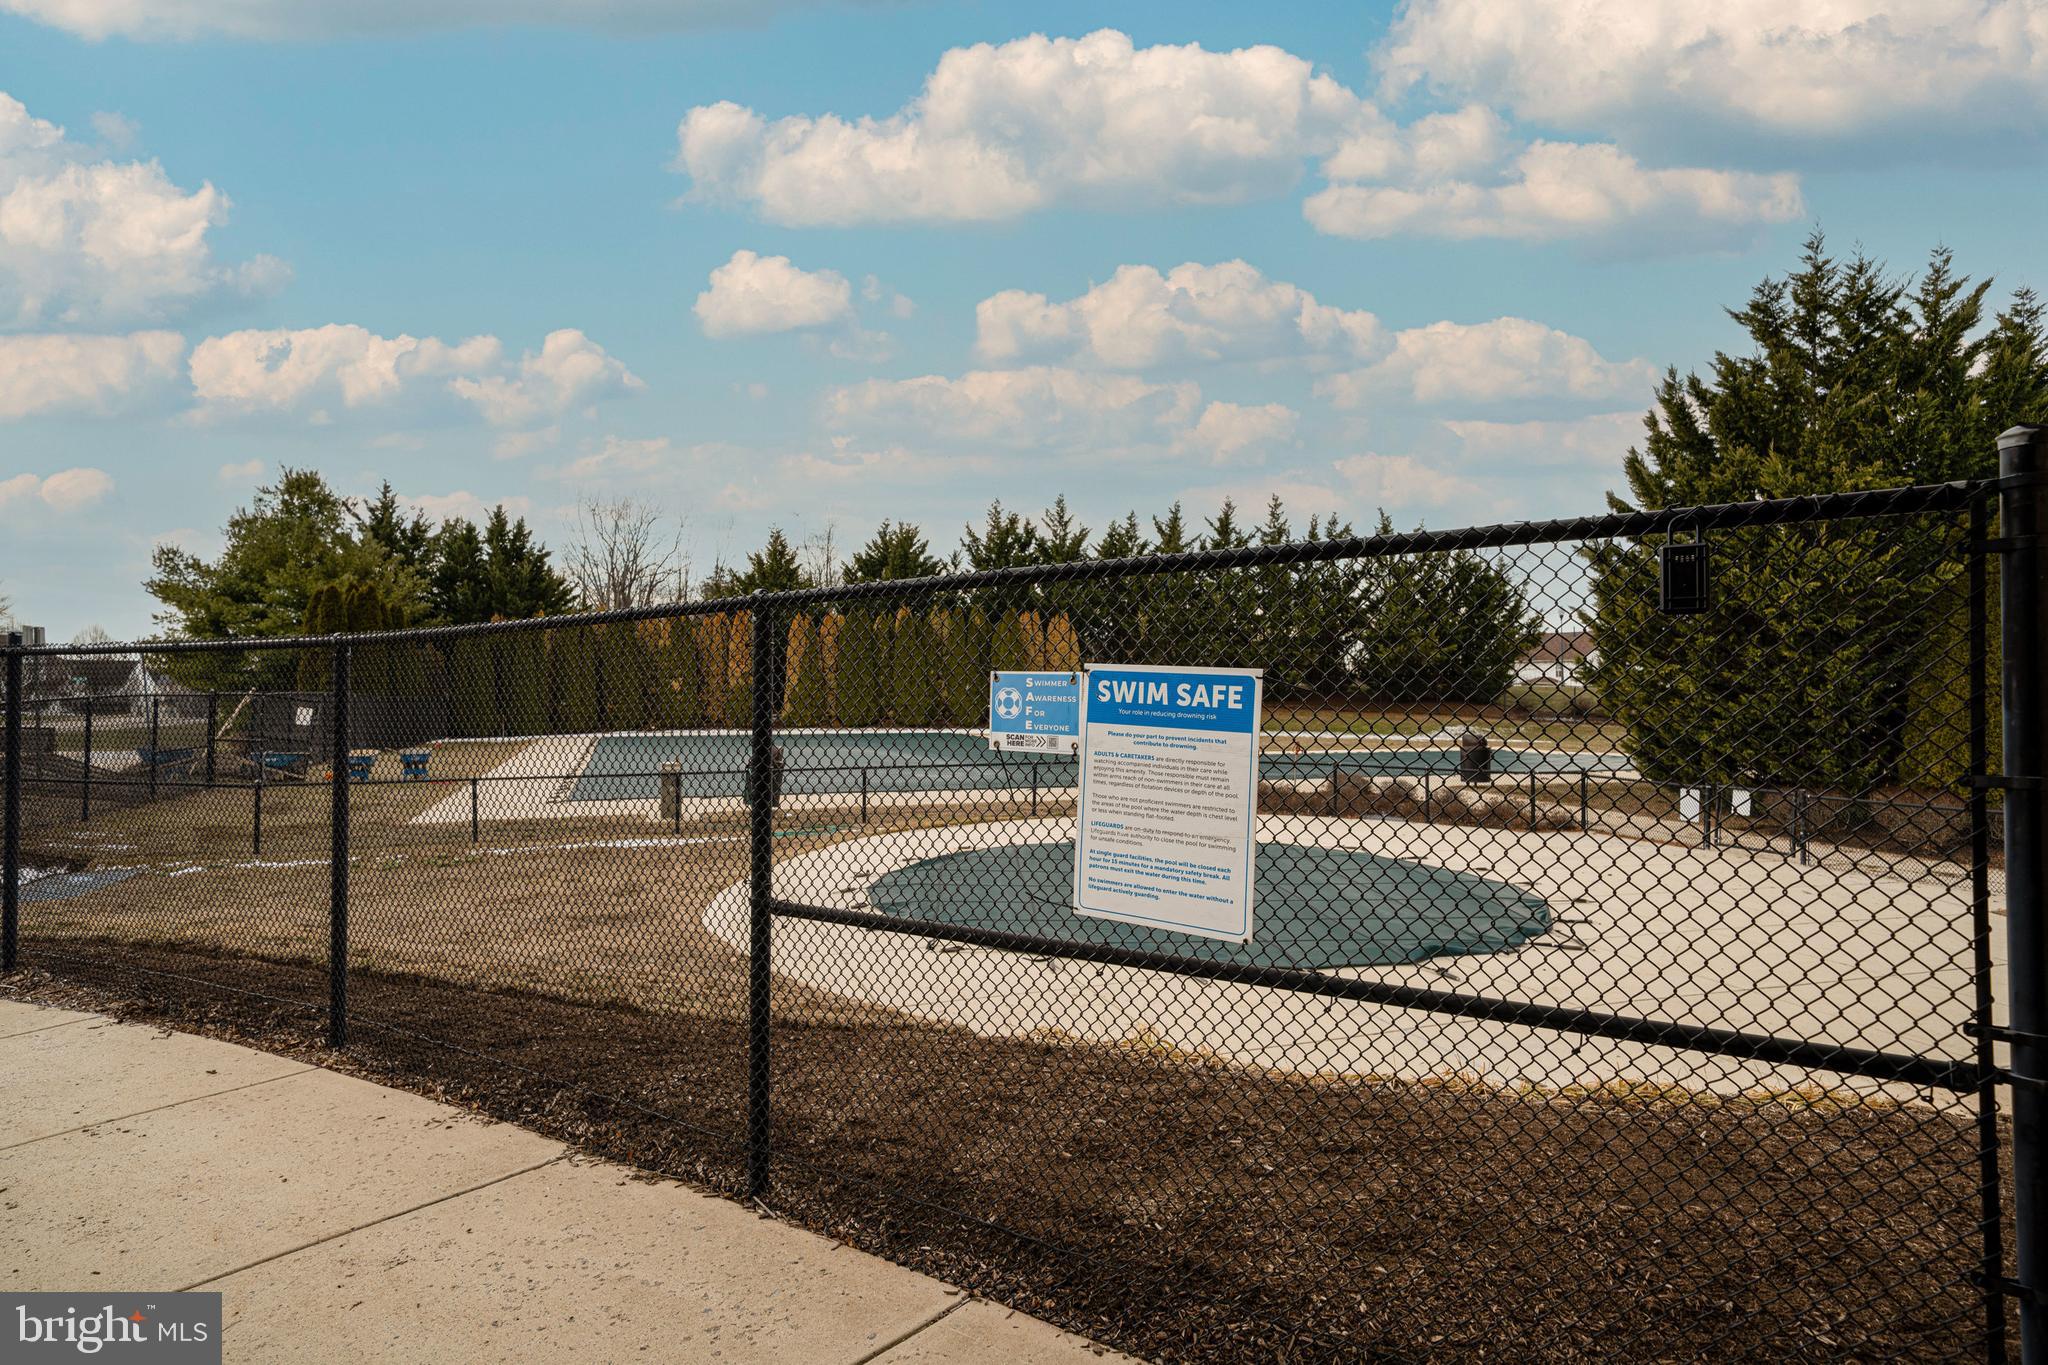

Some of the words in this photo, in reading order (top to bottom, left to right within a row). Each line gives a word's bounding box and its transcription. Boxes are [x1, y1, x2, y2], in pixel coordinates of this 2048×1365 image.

[1026, 678, 1068, 688] SWIMMER
[1026, 692, 1077, 702] AWARENESS
[1097, 680, 1168, 705] SWIM
[1177, 683, 1243, 709] SAFE
[1026, 706, 1045, 717] FOR
[1150, 710, 1176, 719] reducing
[1176, 712, 1205, 720] drowning
[1026, 720, 1070, 732] EVERYONE
[1165, 735, 1187, 743] prevent
[1093, 758, 1116, 767] watching
[1120, 753, 1155, 761] CARETAKERS
[1165, 757, 1184, 765] directly
[1186, 758, 1216, 768] responsible
[1093, 765, 1114, 773] enjoying
[1164, 771, 1194, 781] responsible
[1108, 780, 1134, 789] regardless
[1191, 789, 1207, 797] depth
[1138, 798, 1164, 807] proficient
[1164, 801, 1192, 809] swimmers
[1202, 804, 1228, 813] restricted
[1123, 810, 1145, 819] standing
[1187, 810, 1202, 819] depth
[1090, 820, 1124, 830] LIFEGUARDS
[1134, 826, 1154, 835] on-duty
[1162, 830, 1184, 839] respond
[1130, 833, 1153, 842] authority
[1185, 840, 1198, 848] pool
[1207, 843, 1236, 853] swimming
[1096, 849, 1112, 858] single
[1112, 852, 1129, 860] guard
[1164, 859, 1178, 867] pool
[1089, 862, 1109, 872] patrons
[1161, 873, 1180, 882] during
[1118, 860, 1140, 868] minutes
[1154, 865, 1184, 876] mandatory
[1185, 869, 1202, 878] safety
[1097, 878, 1123, 887] swimmers
[1133, 883, 1155, 892] allowed
[1206, 895, 1228, 904] without
[1112, 887, 1134, 897] actively
